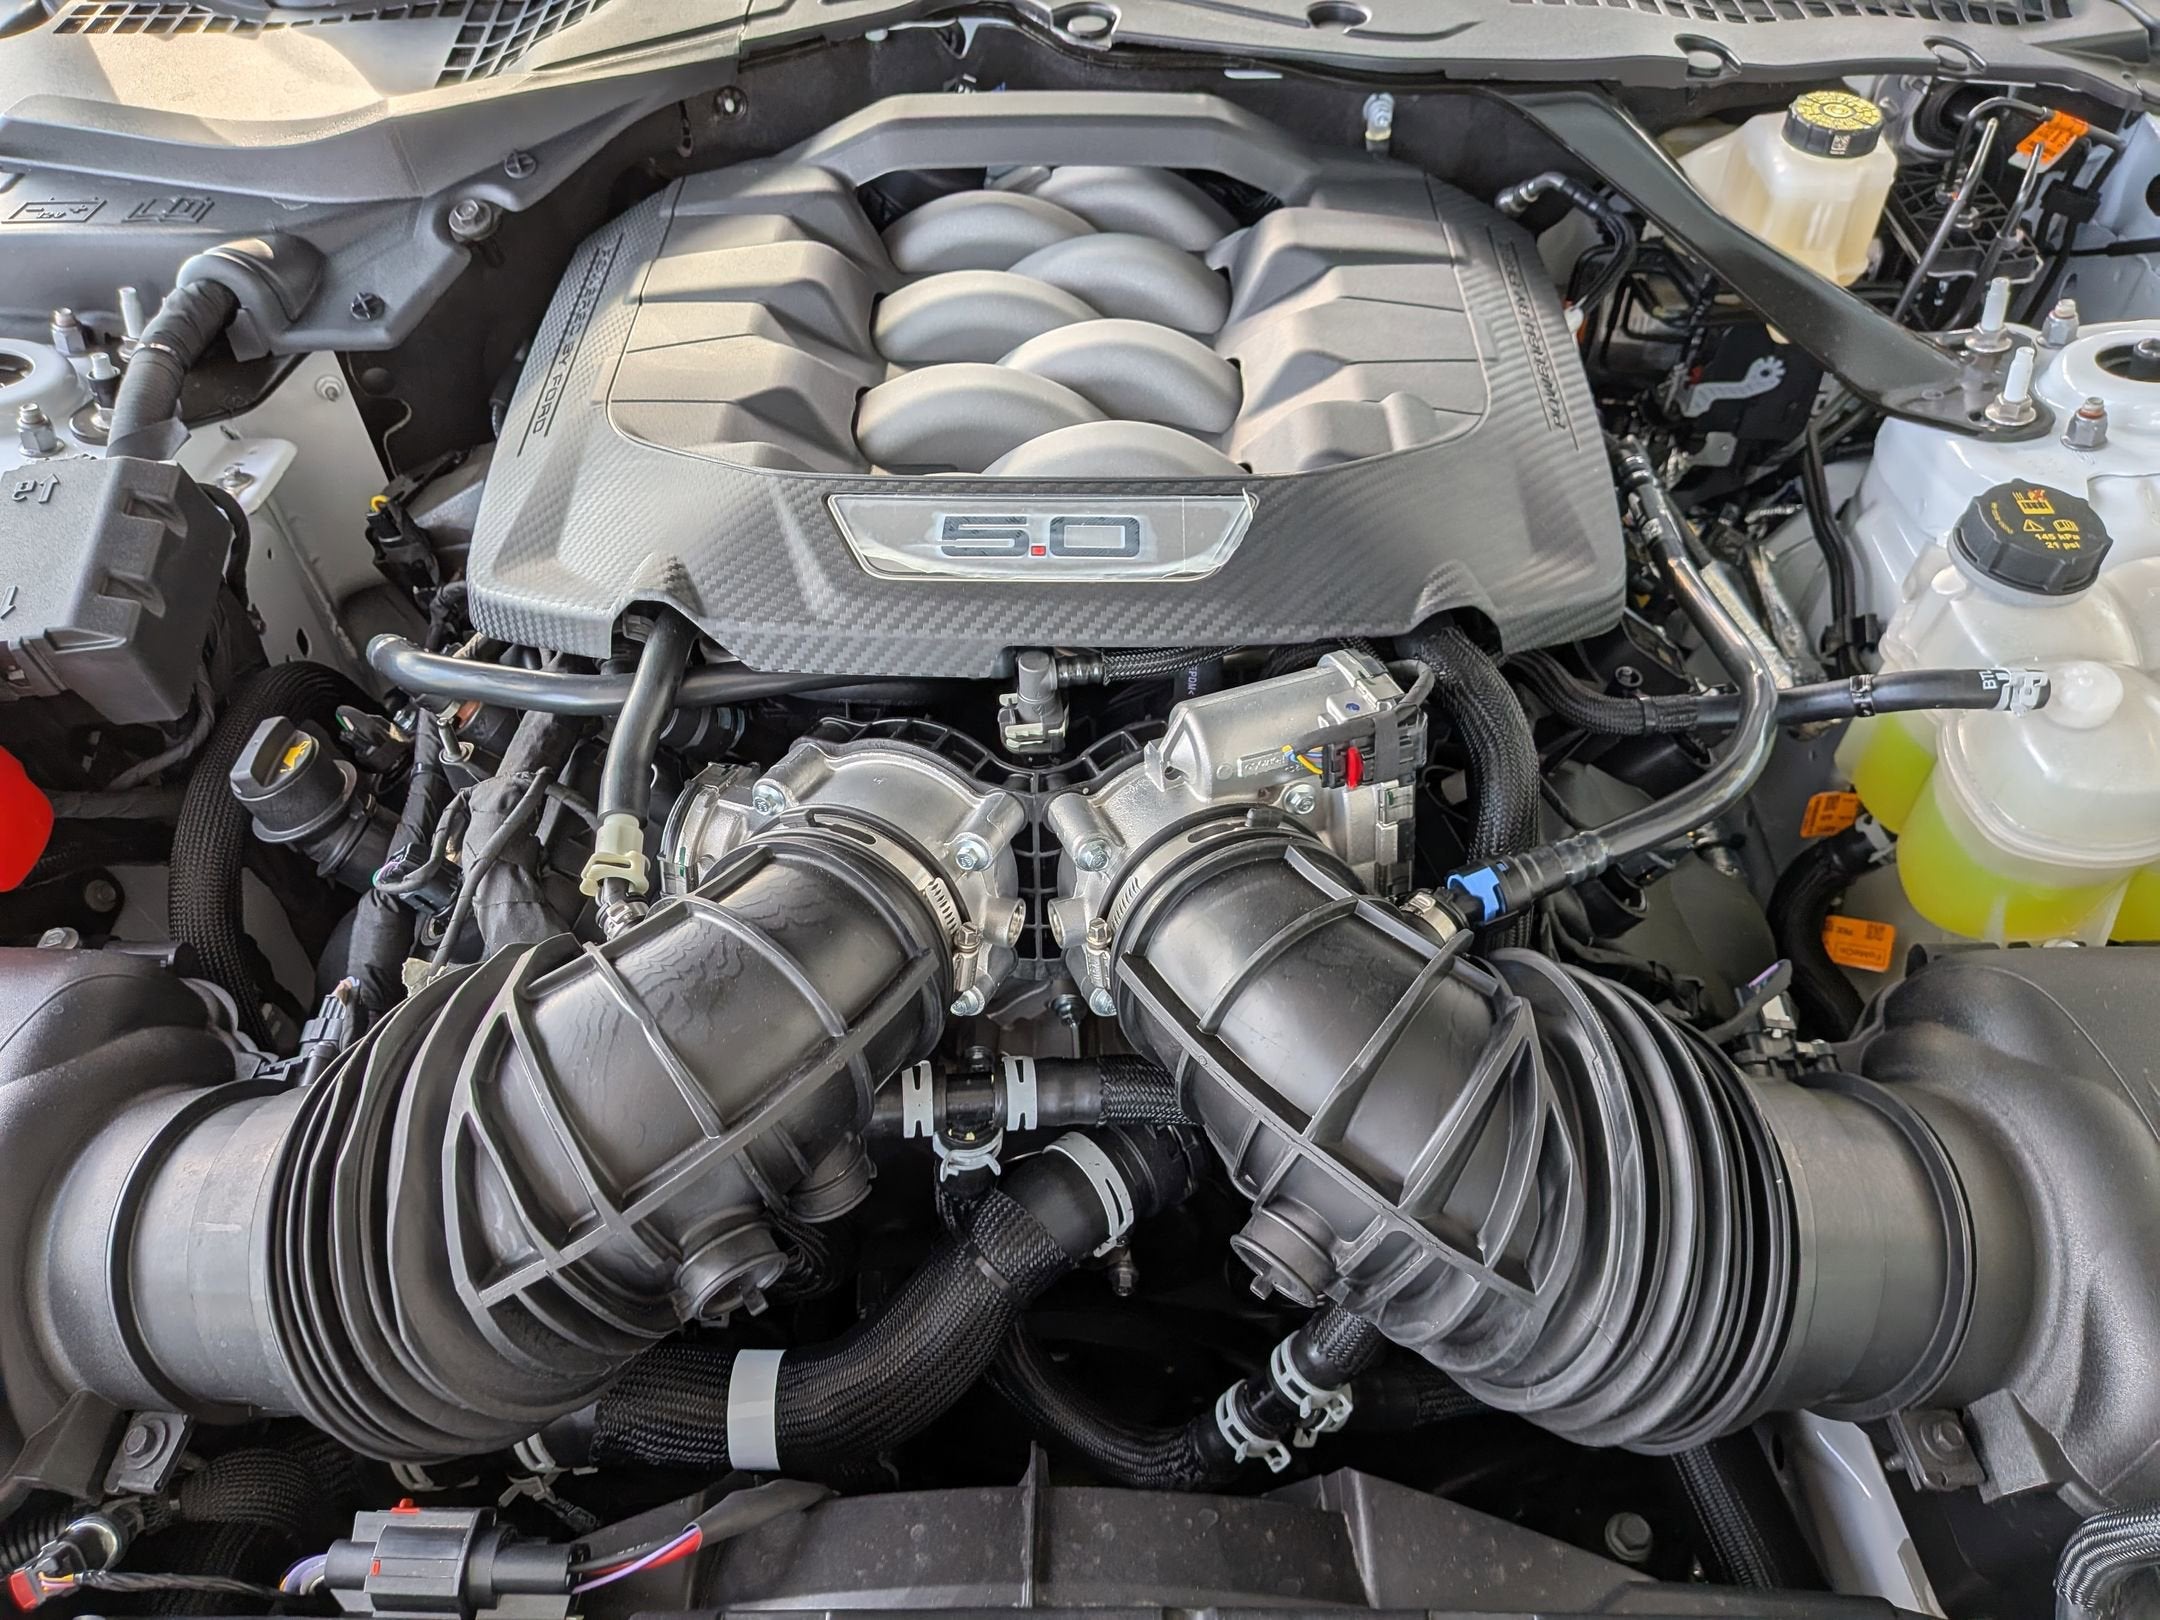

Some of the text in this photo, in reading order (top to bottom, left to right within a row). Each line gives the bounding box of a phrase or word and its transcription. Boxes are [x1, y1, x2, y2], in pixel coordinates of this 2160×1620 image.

[558, 342, 574, 367] BY
[1523, 322, 1567, 430] POWERED
[532, 373, 563, 435] FORD
[940, 514, 1141, 558] 5.0
[2035, 533, 2081, 541] 145 kPa
[2045, 541, 2081, 550] 21 psi
